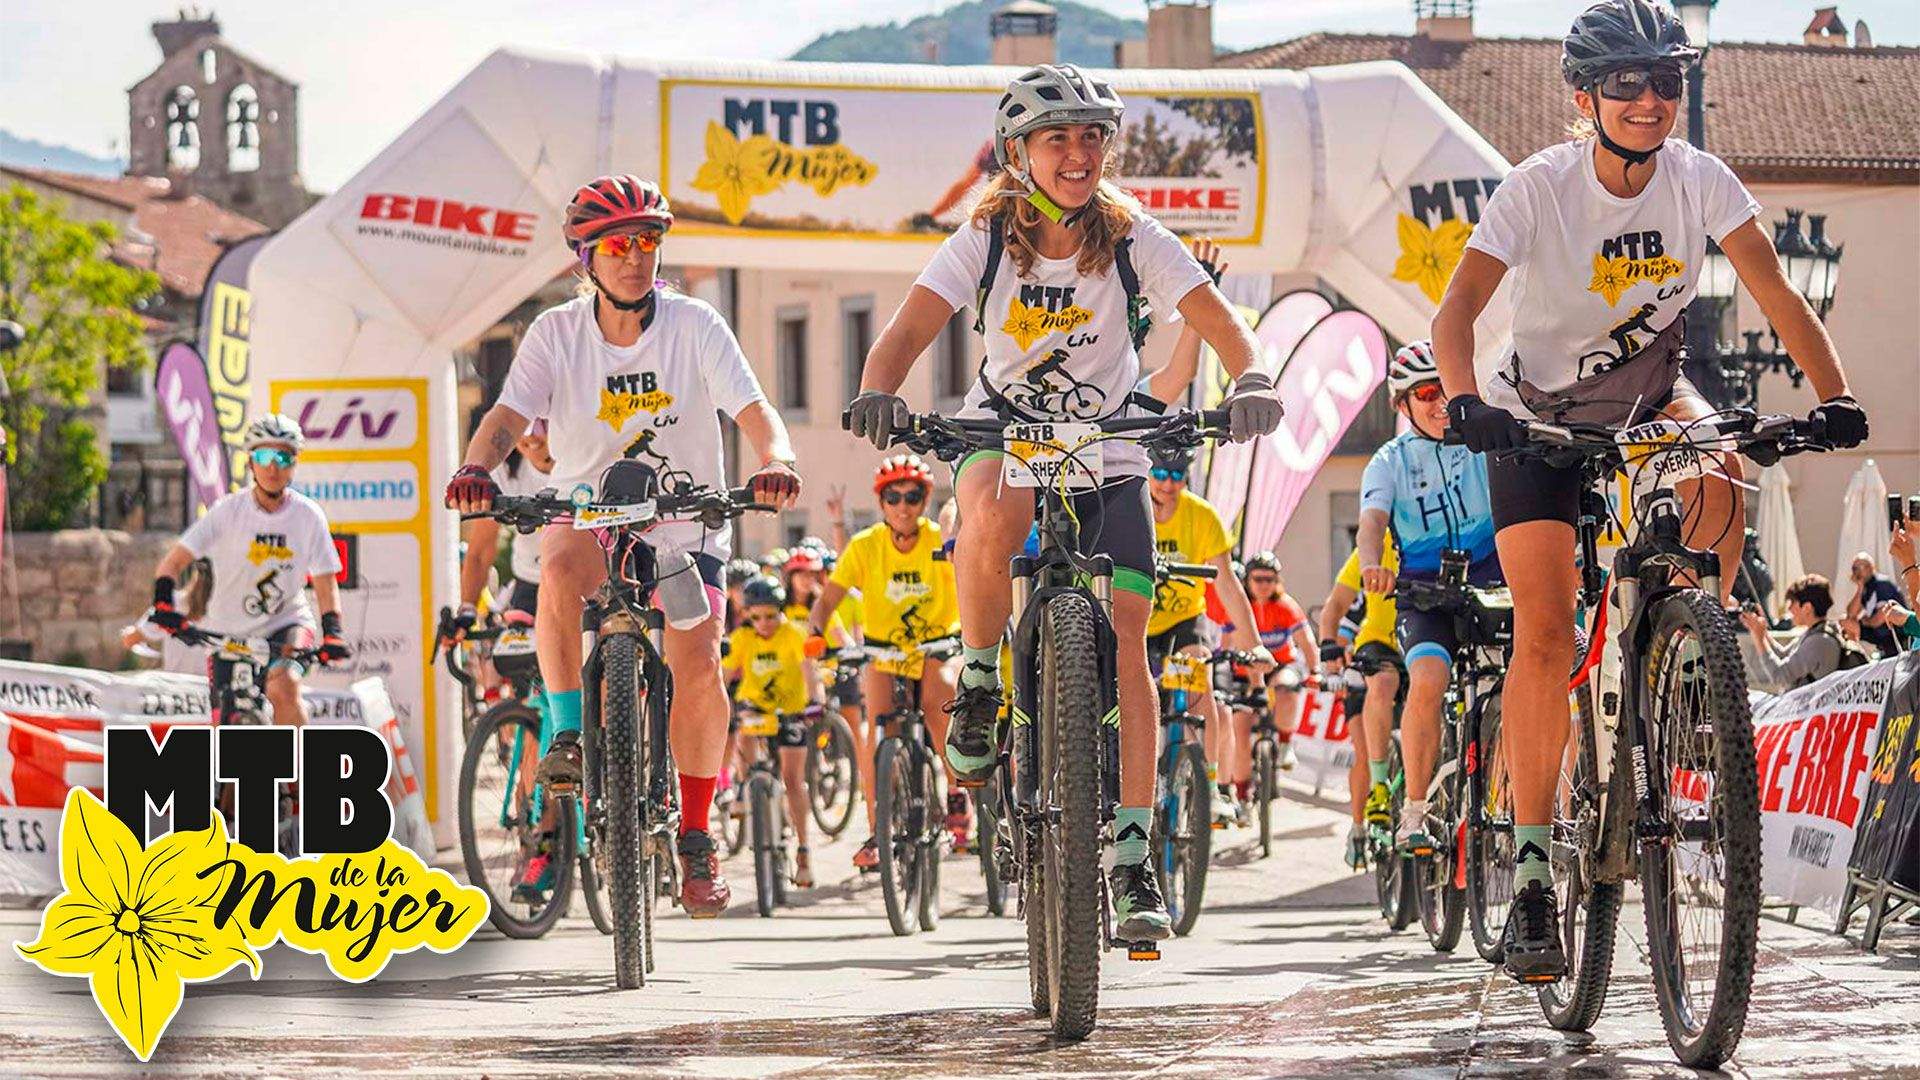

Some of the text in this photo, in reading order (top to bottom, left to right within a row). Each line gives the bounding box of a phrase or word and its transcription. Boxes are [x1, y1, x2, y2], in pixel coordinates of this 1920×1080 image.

[724, 98, 840, 146] MTB
[760, 148, 870, 197] Mujer
[361, 192, 539, 243] BIKE
[357, 223, 528, 258] www.mountainbike.es
[1601, 230, 1665, 264] MTB
[1621, 260, 1681, 283] Mujer
[1038, 311, 1089, 332] Mujer
[1066, 332, 1099, 348] Liv
[606, 371, 658, 396] MTB
[298, 398, 400, 440] Liv
[653, 414, 679, 428] Liv
[1016, 424, 1055, 442] MTB
[1625, 422, 1668, 444] MTB
[1031, 460, 1076, 478] SHERA
[294, 480, 414, 501] HIMANO
[892, 571, 922, 585] MTB
[1787, 710, 1880, 830] BIKE
